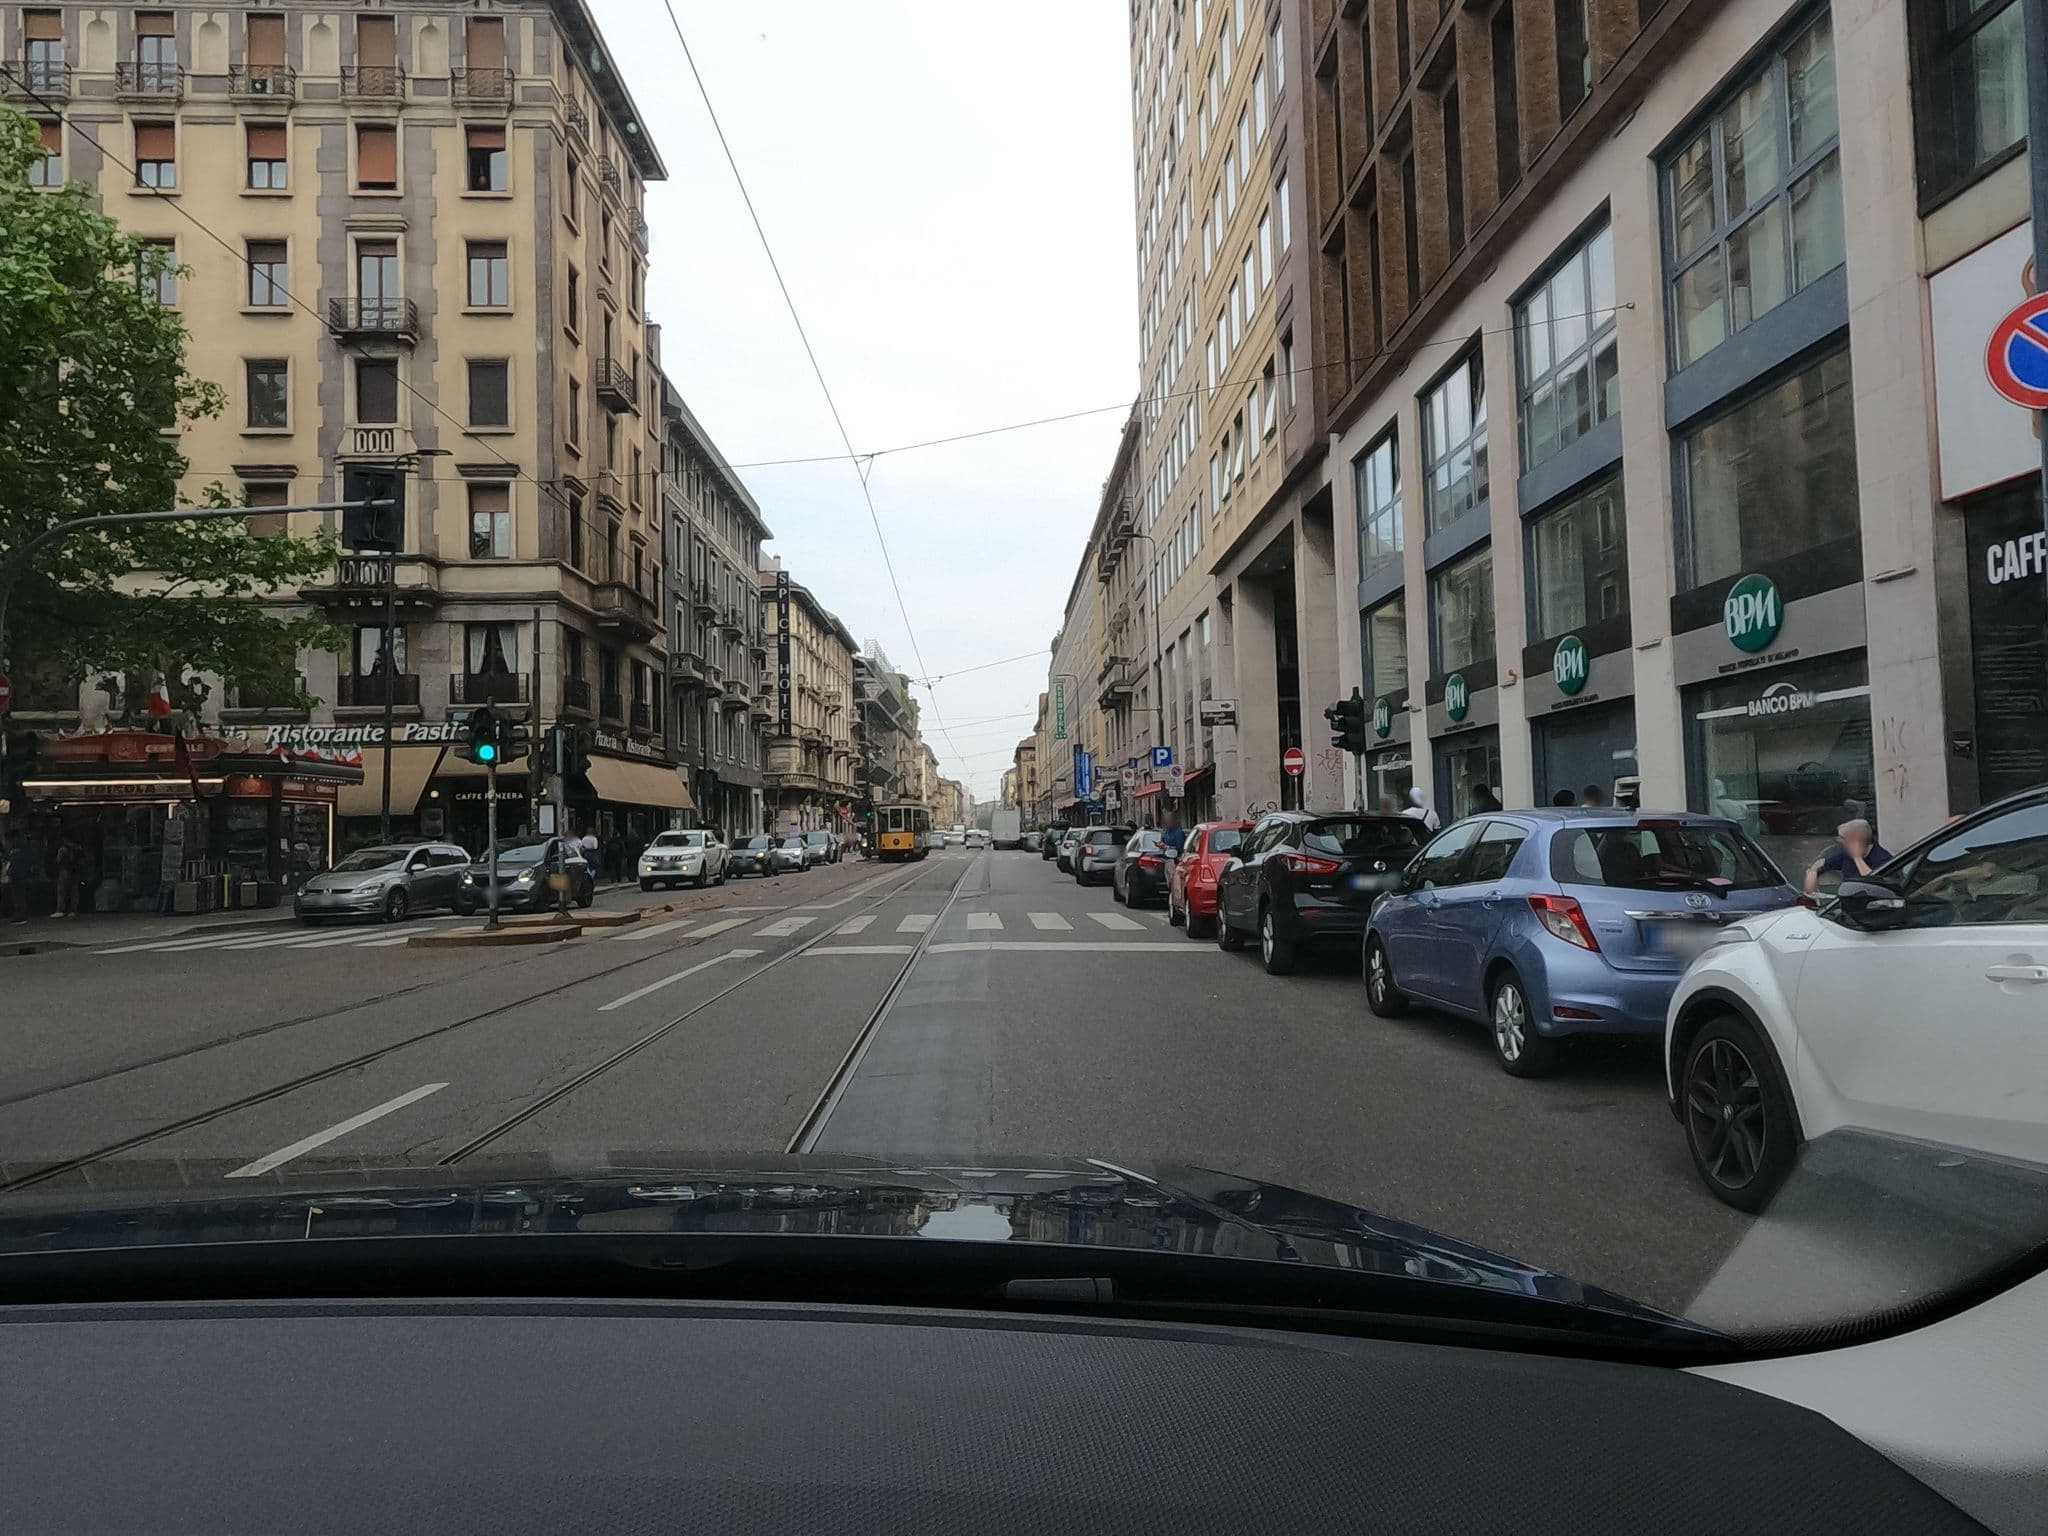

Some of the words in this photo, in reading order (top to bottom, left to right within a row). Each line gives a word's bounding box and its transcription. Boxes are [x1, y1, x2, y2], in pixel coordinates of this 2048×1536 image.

[778, 573, 790, 645] SPICE
[1725, 586, 1777, 638] BPM
[1554, 646, 1585, 684] BPM
[778, 663, 790, 735] HOTEL
[1445, 682, 1466, 712] BPM
[1748, 694, 1788, 717] BANCO
[1789, 690, 1815, 710] BPM
[1374, 706, 1388, 731] BPM
[264, 724, 385, 744] Ristorante
[1156, 749, 1169, 765] P
[455, 793, 482, 801] CAFFE
[484, 792, 524, 801] PNZERA
